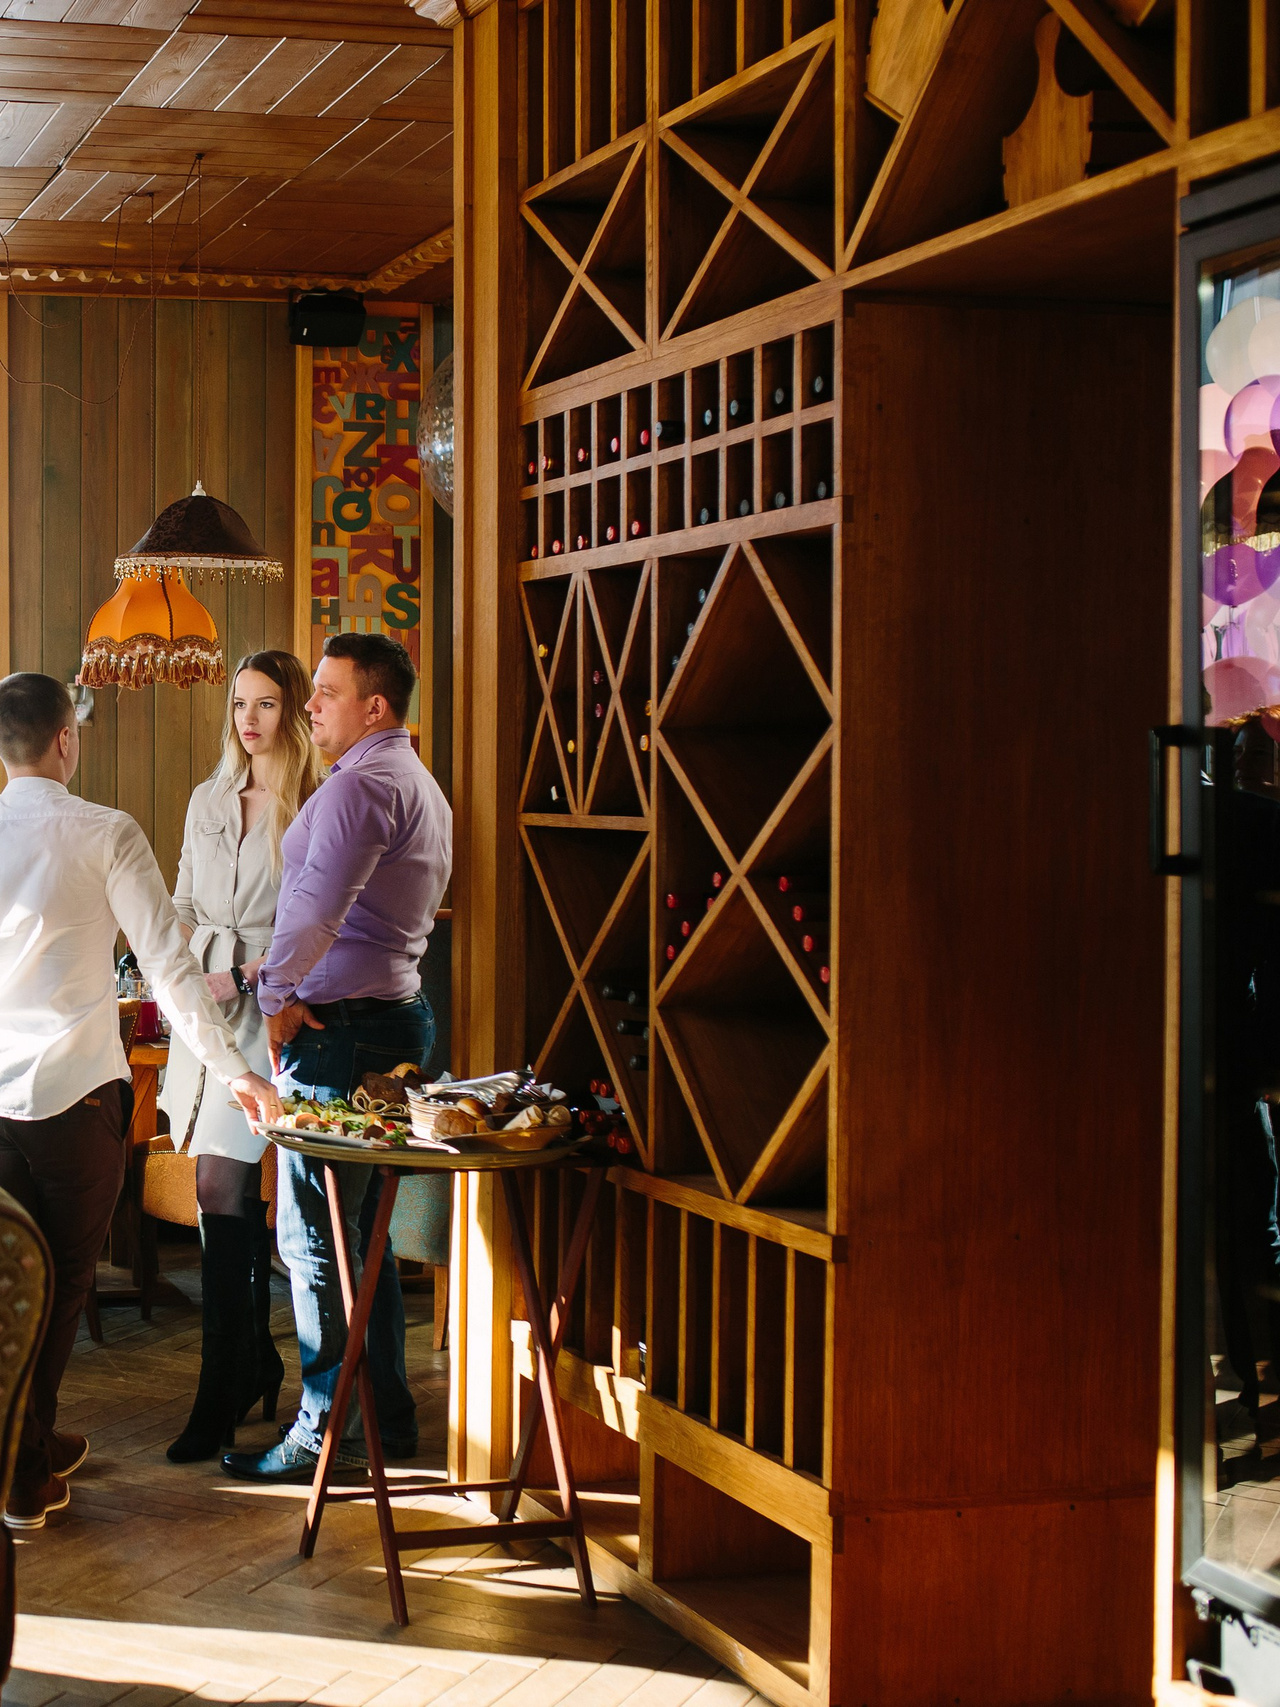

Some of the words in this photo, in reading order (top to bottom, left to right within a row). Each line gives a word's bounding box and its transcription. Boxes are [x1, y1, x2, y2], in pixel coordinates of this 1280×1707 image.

[385, 331, 419, 372] X
[328, 393, 356, 420] V
[355, 393, 387, 421] R
[385, 400, 419, 446] H
[343, 422, 386, 468] Z
[332, 487, 373, 532] Q
[376, 483, 420, 524] O
[393, 526, 420, 568] T
[312, 558, 340, 597] a
[381, 583, 421, 629] S
